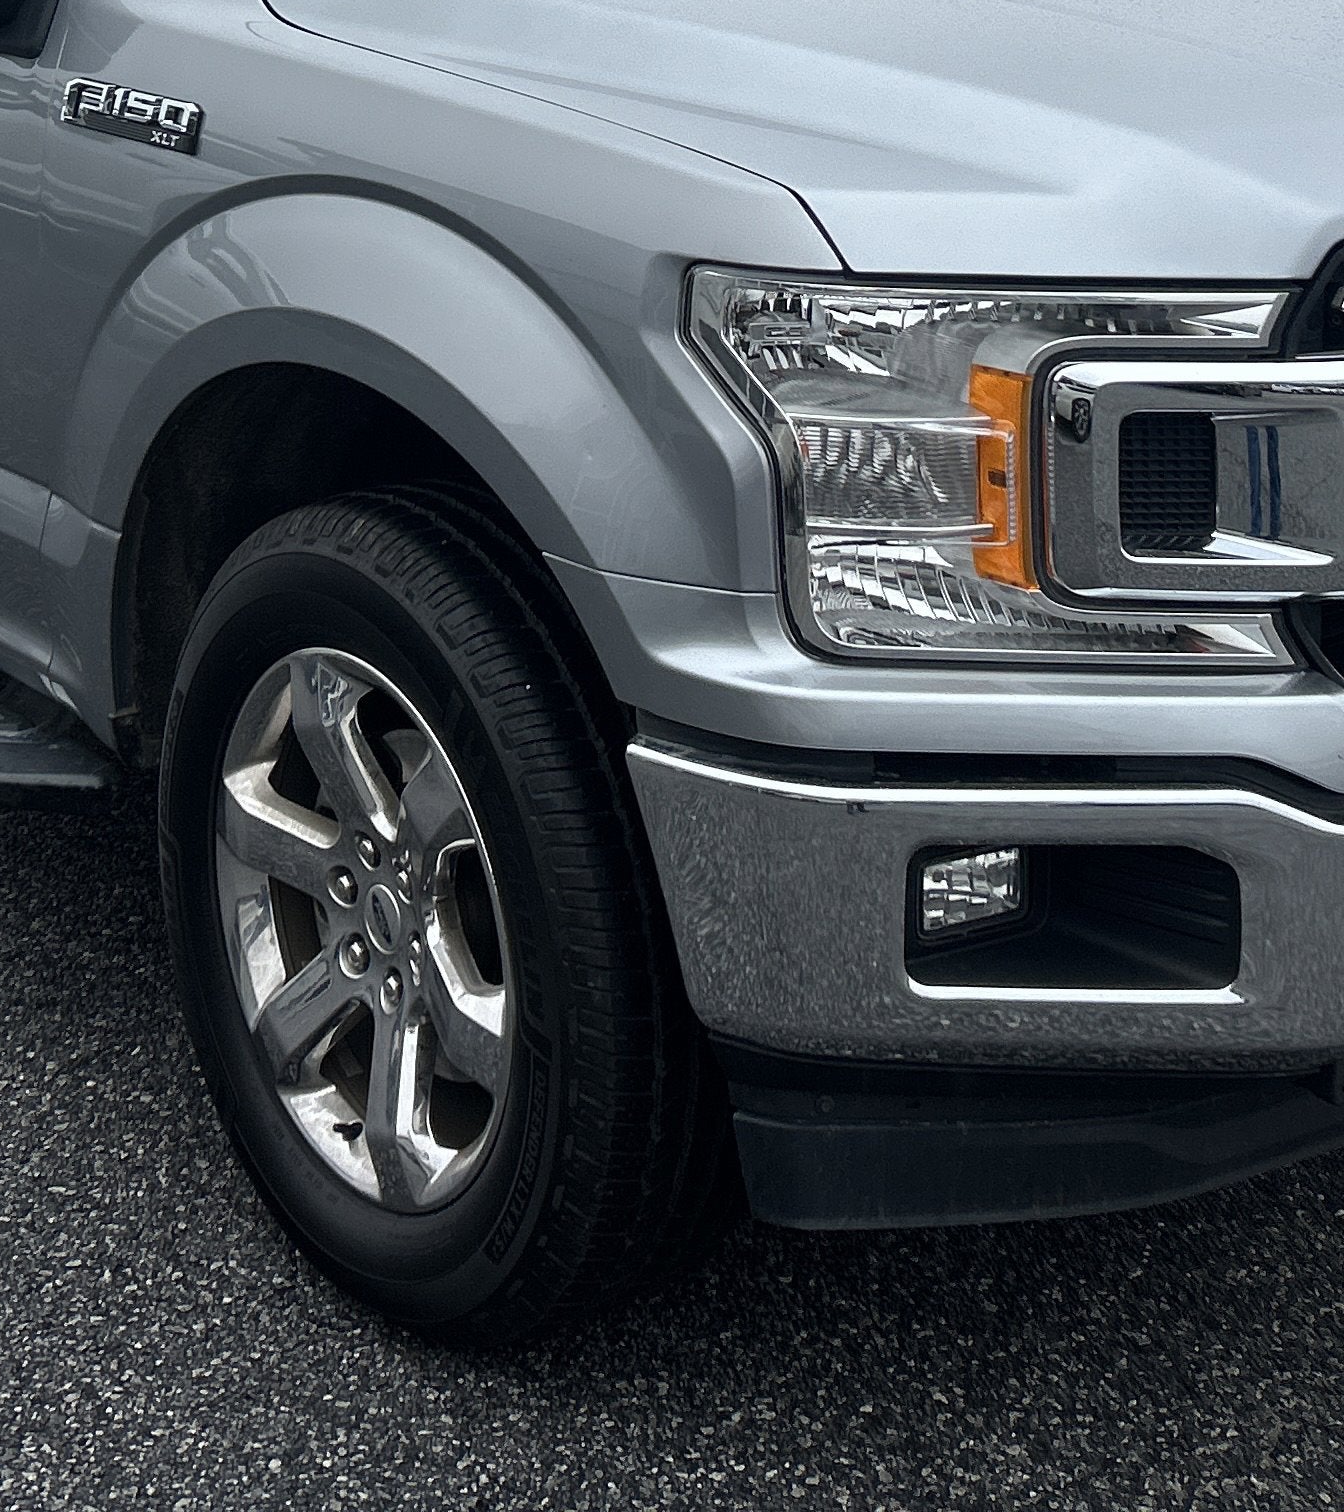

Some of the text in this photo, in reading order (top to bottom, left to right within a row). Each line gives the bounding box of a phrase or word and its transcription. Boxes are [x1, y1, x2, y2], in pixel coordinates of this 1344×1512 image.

[150, 130, 180, 147] XLT
[520, 1069, 548, 1183] DEFENDER
[509, 1179, 530, 1219] LTX
